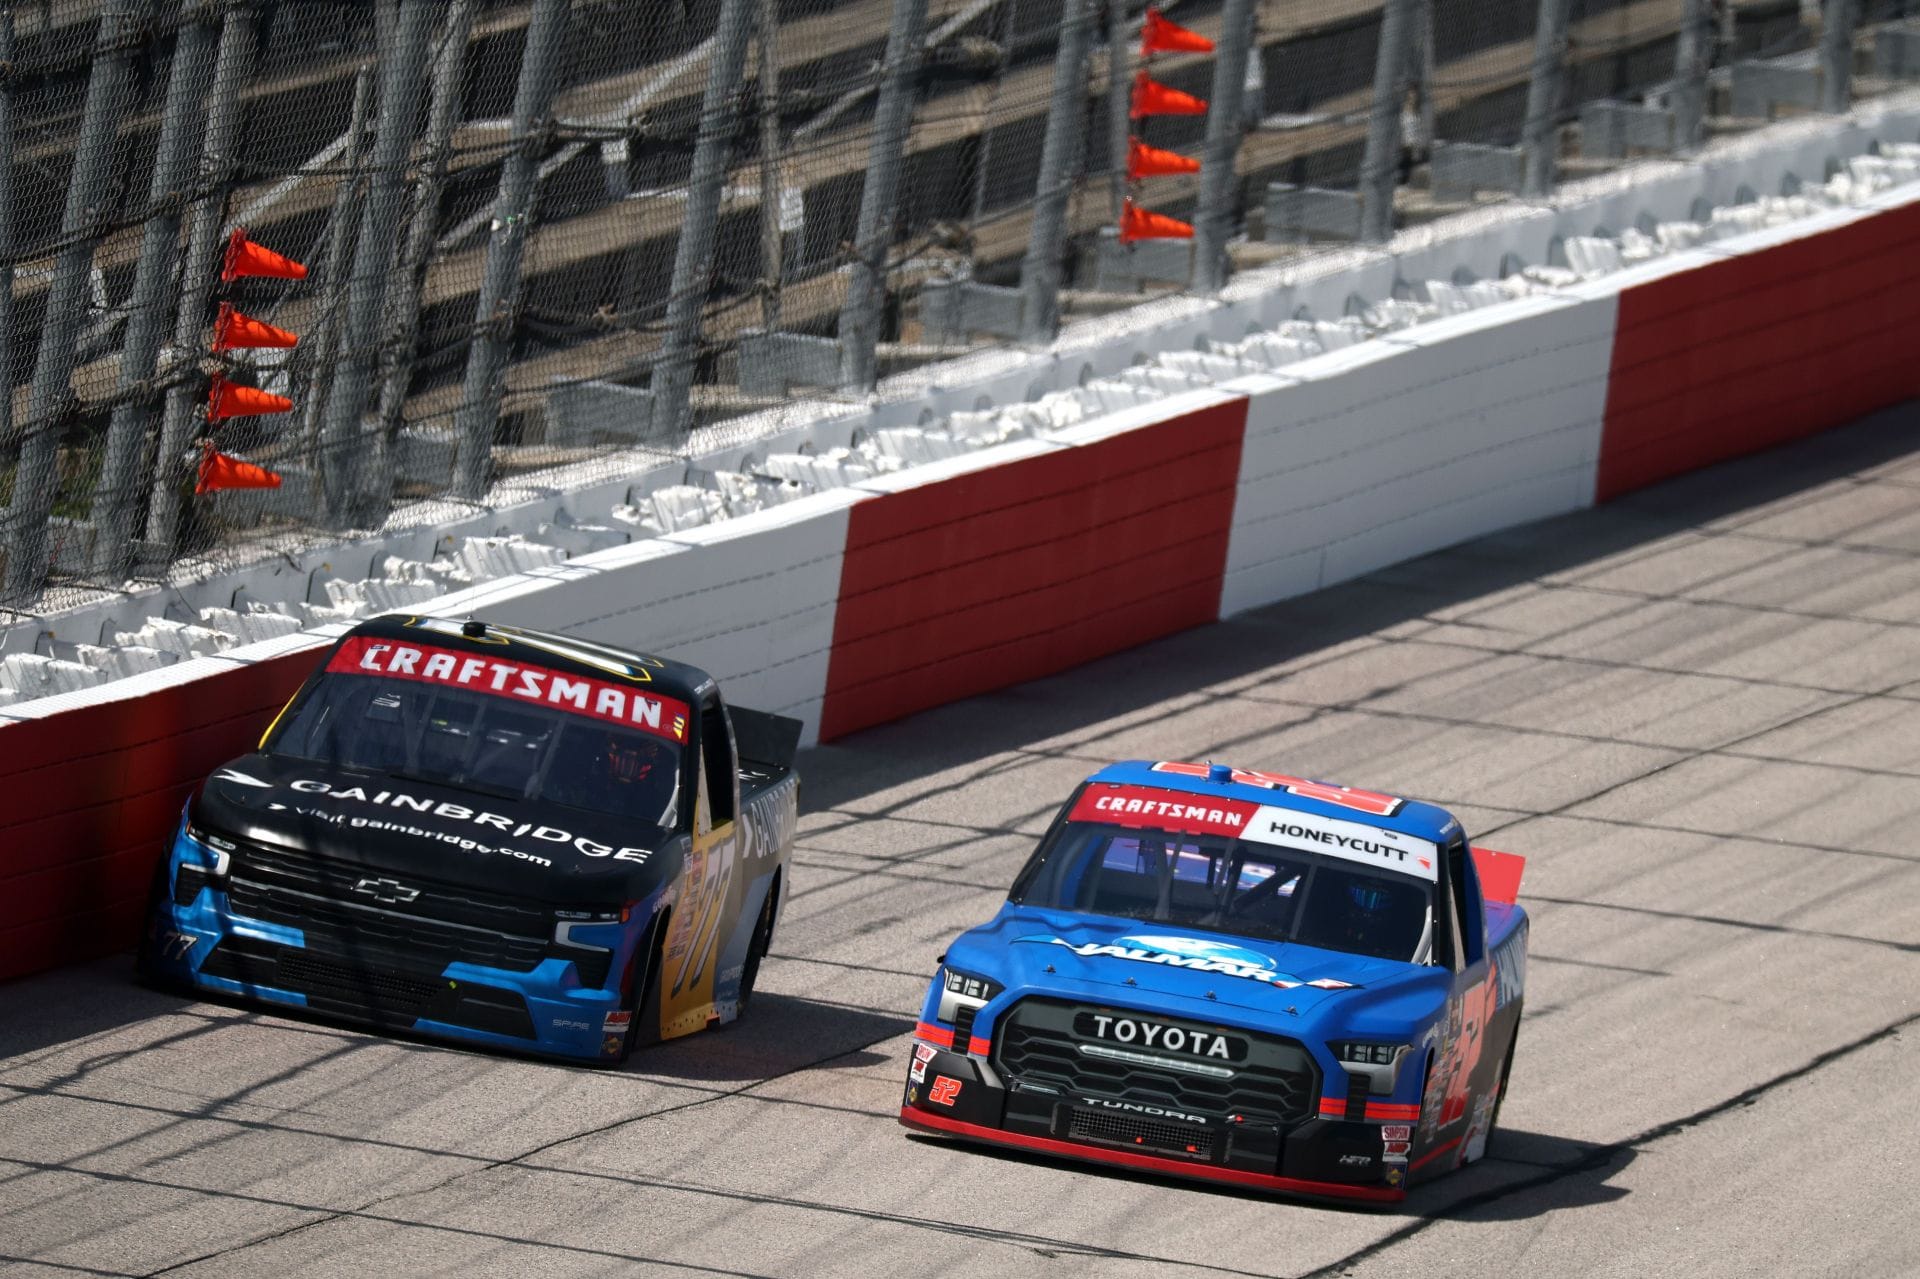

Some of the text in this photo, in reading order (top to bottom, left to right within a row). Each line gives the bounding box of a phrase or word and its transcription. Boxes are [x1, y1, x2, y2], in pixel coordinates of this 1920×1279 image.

[359, 645, 662, 729] CRAFTSMAN
[290, 780, 653, 864] GAINBRIDGE
[1095, 796, 1241, 826] CRAFTSMAN
[296, 807, 552, 868] visit gainbridge.com
[1269, 821, 1409, 862] HONEYCUTT
[1094, 1015, 1230, 1060] TOYOTA
[928, 1074, 963, 1107] 52
[1082, 1097, 1207, 1124] TUNDRA
